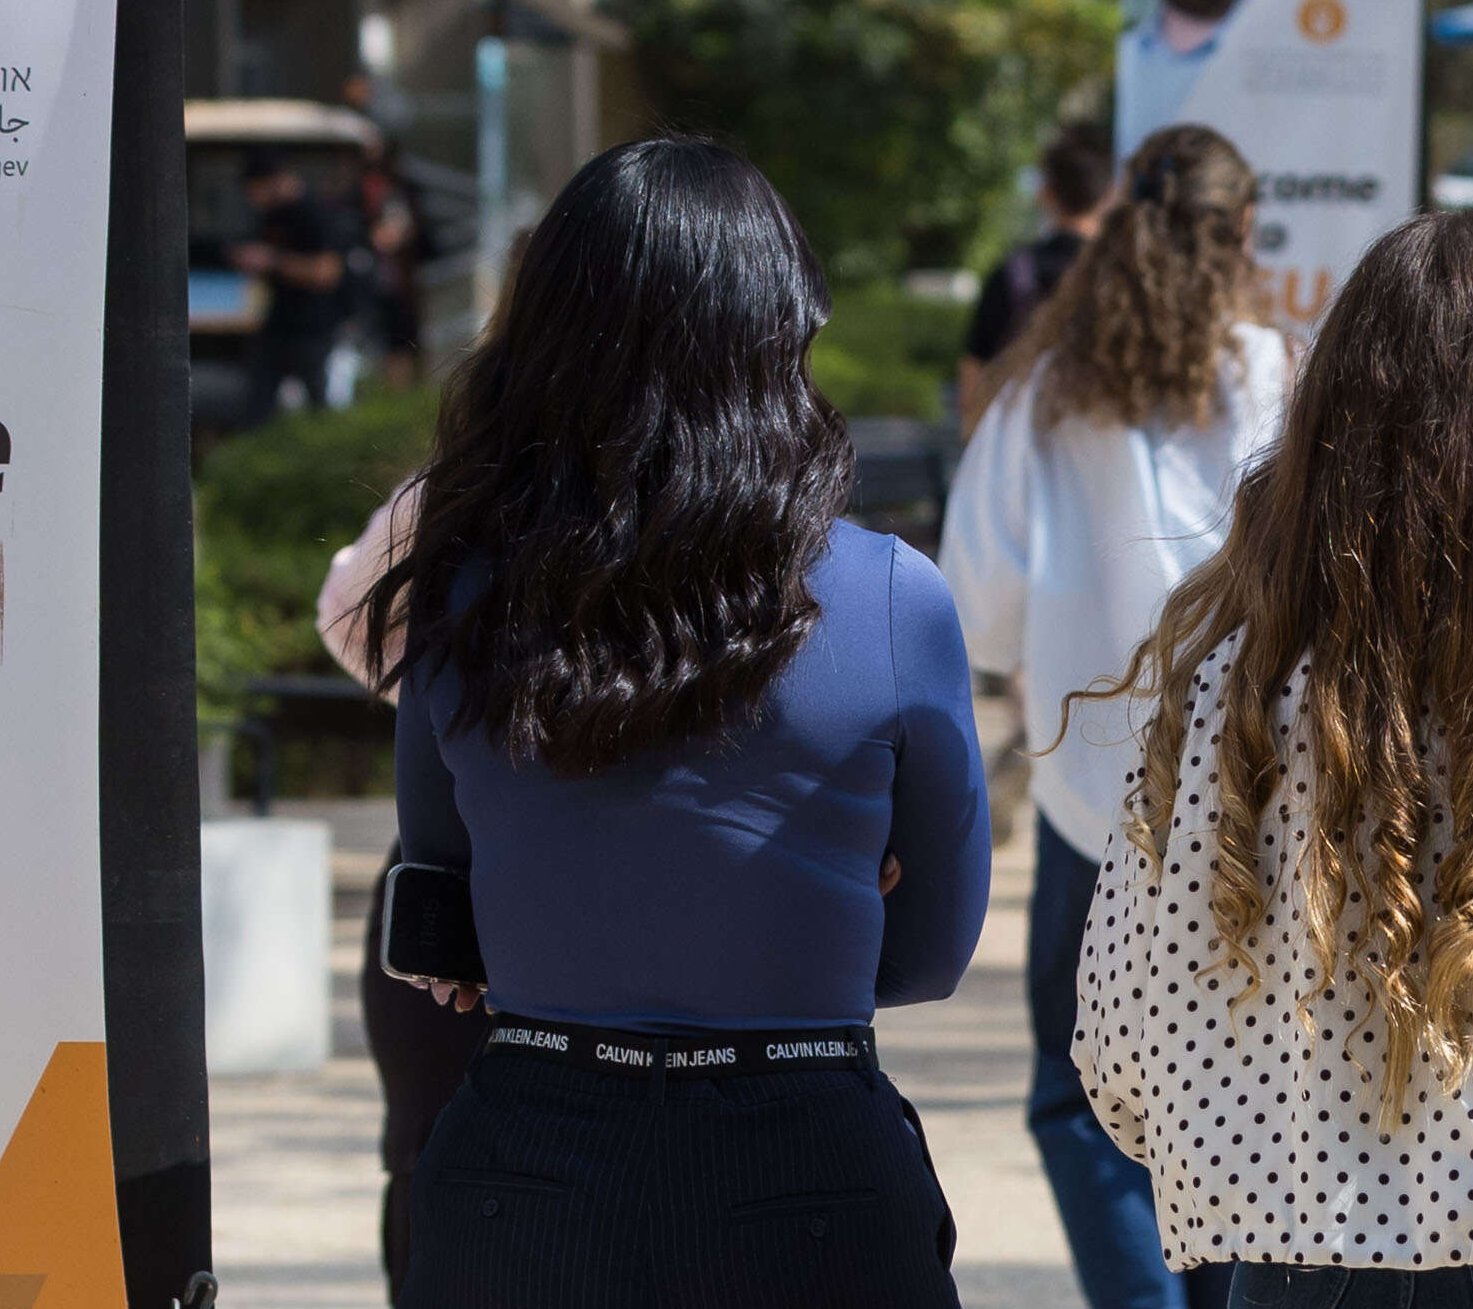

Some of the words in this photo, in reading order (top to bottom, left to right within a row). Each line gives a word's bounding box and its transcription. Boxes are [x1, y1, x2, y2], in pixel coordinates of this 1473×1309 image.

[531, 1030, 569, 1052] JEANS
[766, 1041, 813, 1060] CALVIN
[813, 1040, 845, 1057] KLEIN
[596, 1043, 644, 1067] CALVIN
[646, 1051, 688, 1068] KEIN
[688, 1047, 737, 1067] JEANS
